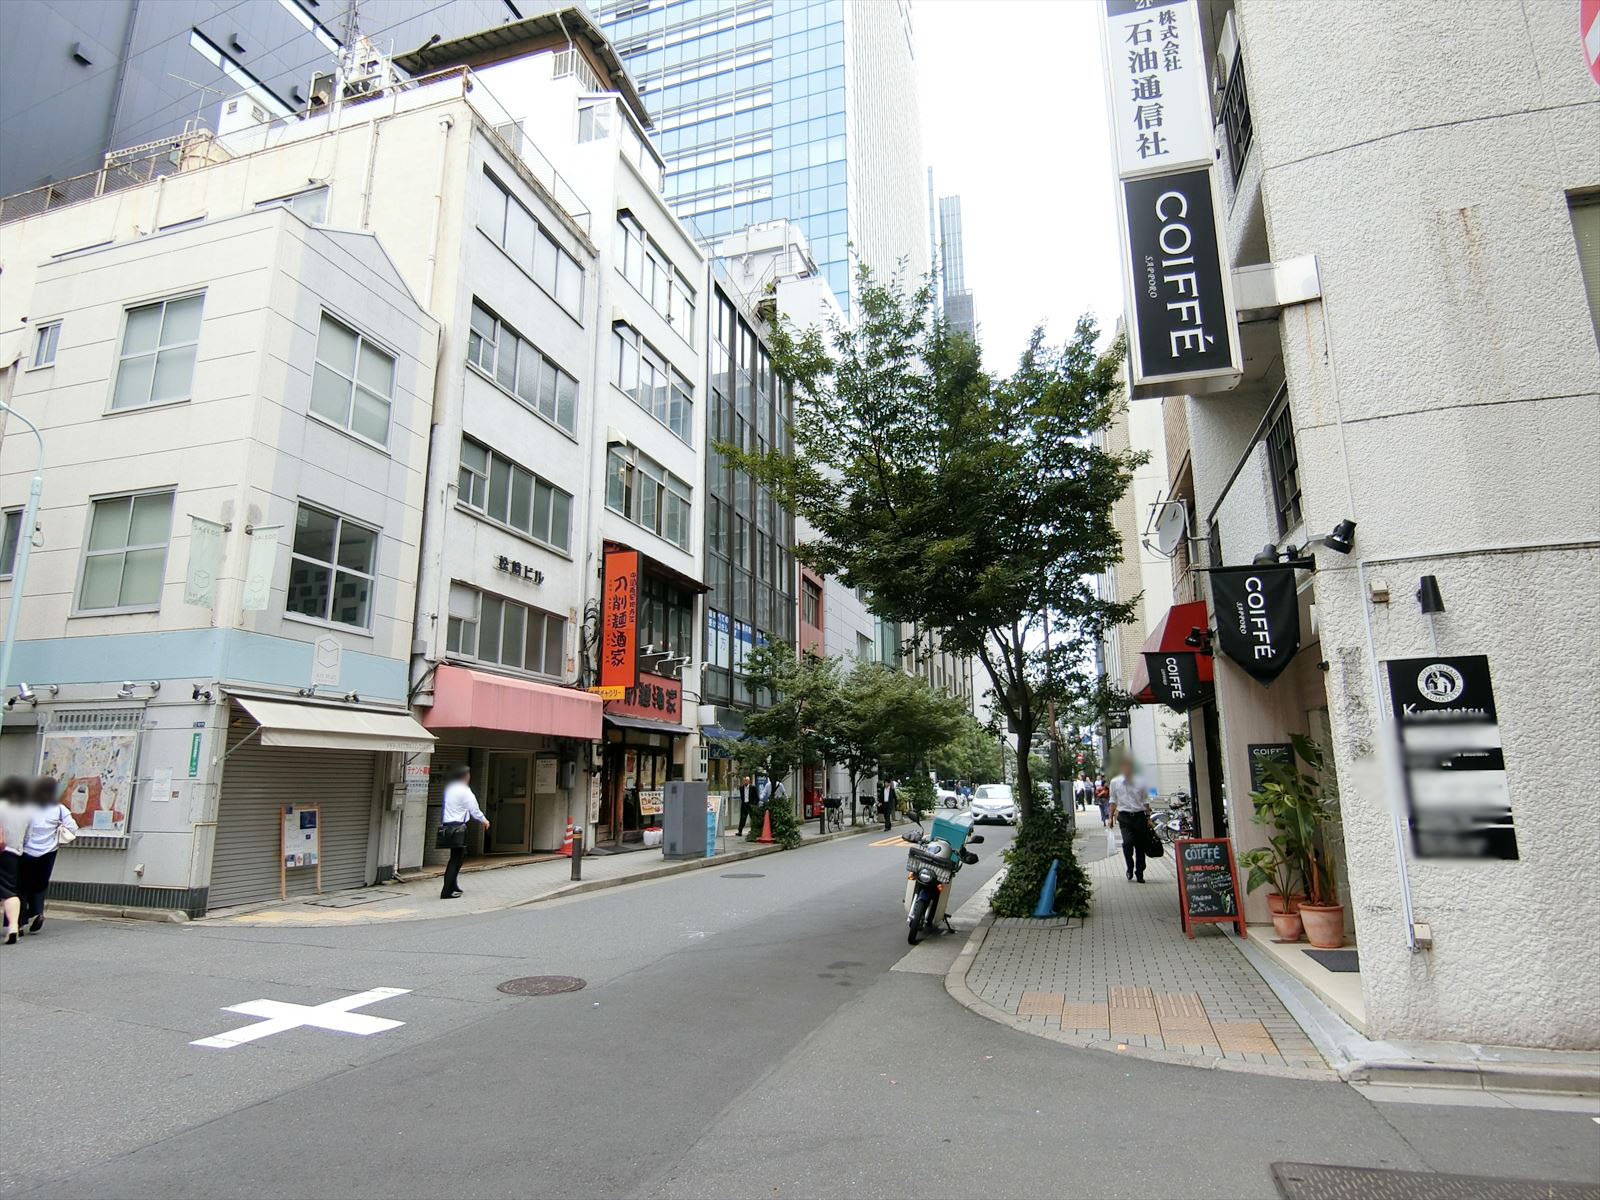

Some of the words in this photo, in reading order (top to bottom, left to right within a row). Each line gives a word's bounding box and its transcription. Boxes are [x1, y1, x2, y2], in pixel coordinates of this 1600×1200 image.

[1158, 9, 1182, 72] 株式会社
[1124, 19, 1169, 159] 石油通信社
[1145, 255, 1158, 299] SAPPORO
[1155, 191, 1214, 358] COIFFÉ
[1236, 601, 1247, 634] SAPPORO
[1245, 577, 1276, 659] COIFFÉ
[1165, 657, 1186, 699] COIFFÉ
